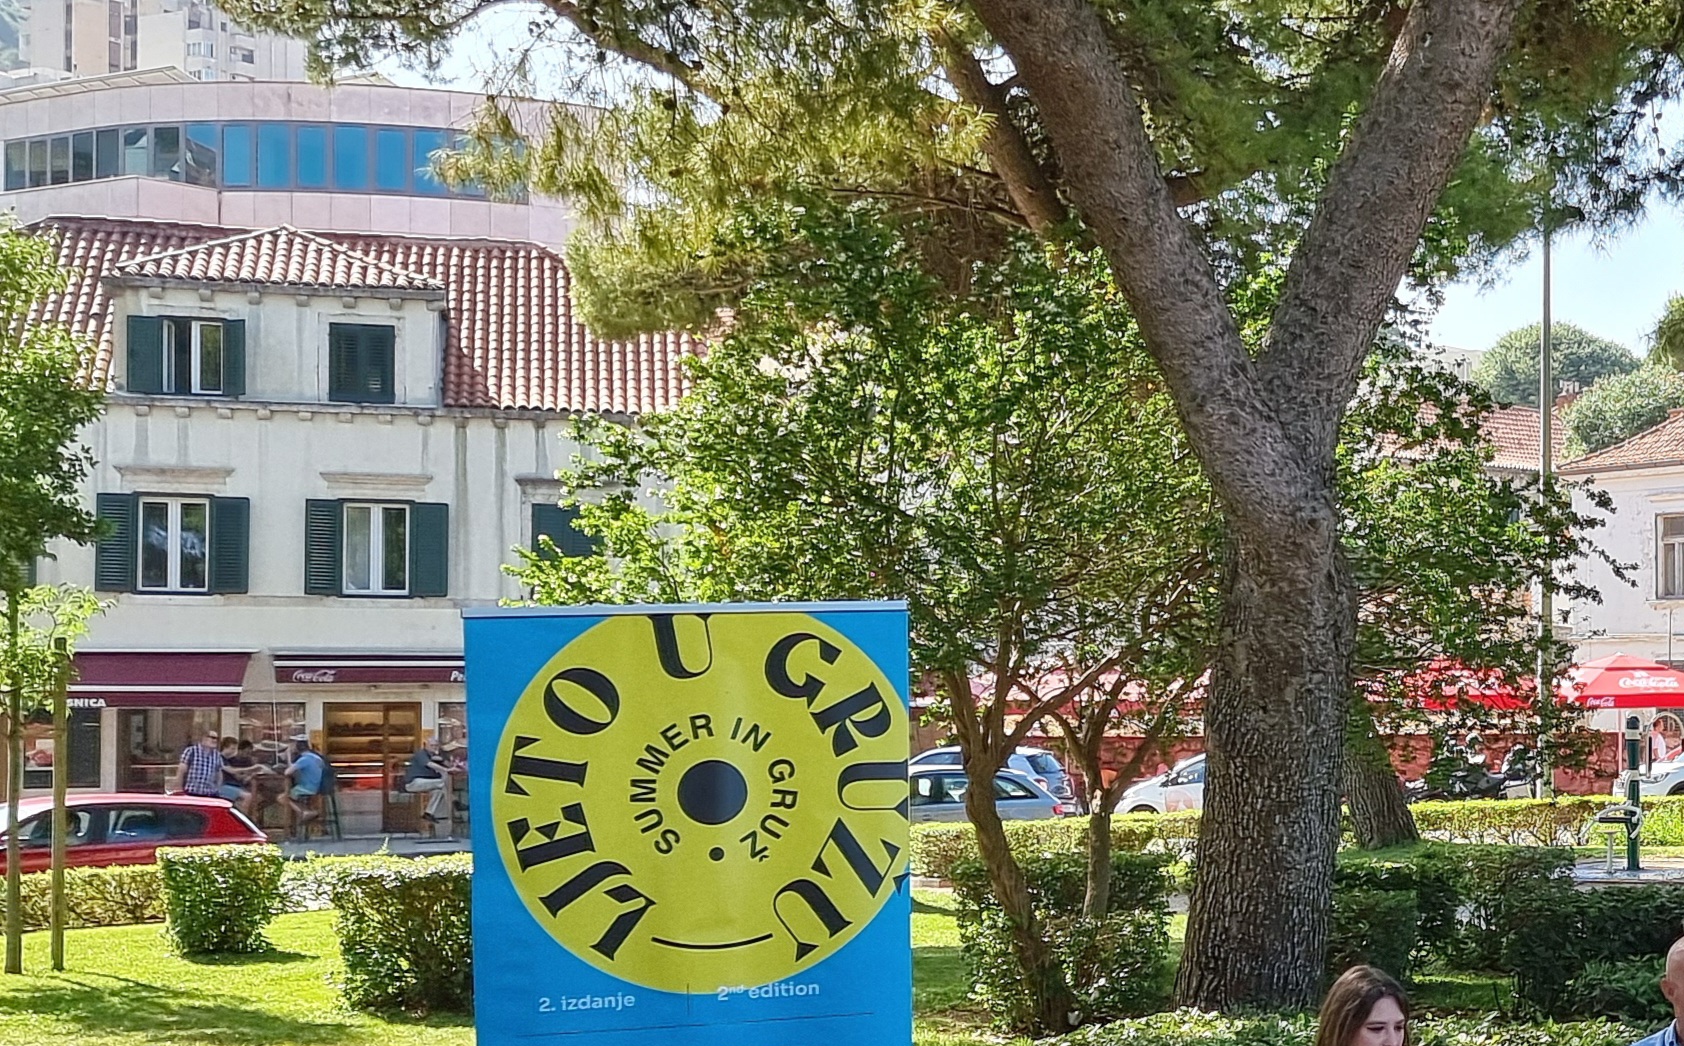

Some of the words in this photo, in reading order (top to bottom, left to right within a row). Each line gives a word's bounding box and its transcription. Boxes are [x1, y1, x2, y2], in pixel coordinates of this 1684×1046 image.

[647, 613, 713, 679] U
[629, 713, 714, 855] SUMMER
[730, 717, 772, 752] IN
[539, 997, 556, 1012] 2.
[560, 992, 636, 1011] izdanje
[748, 982, 820, 999] edition
